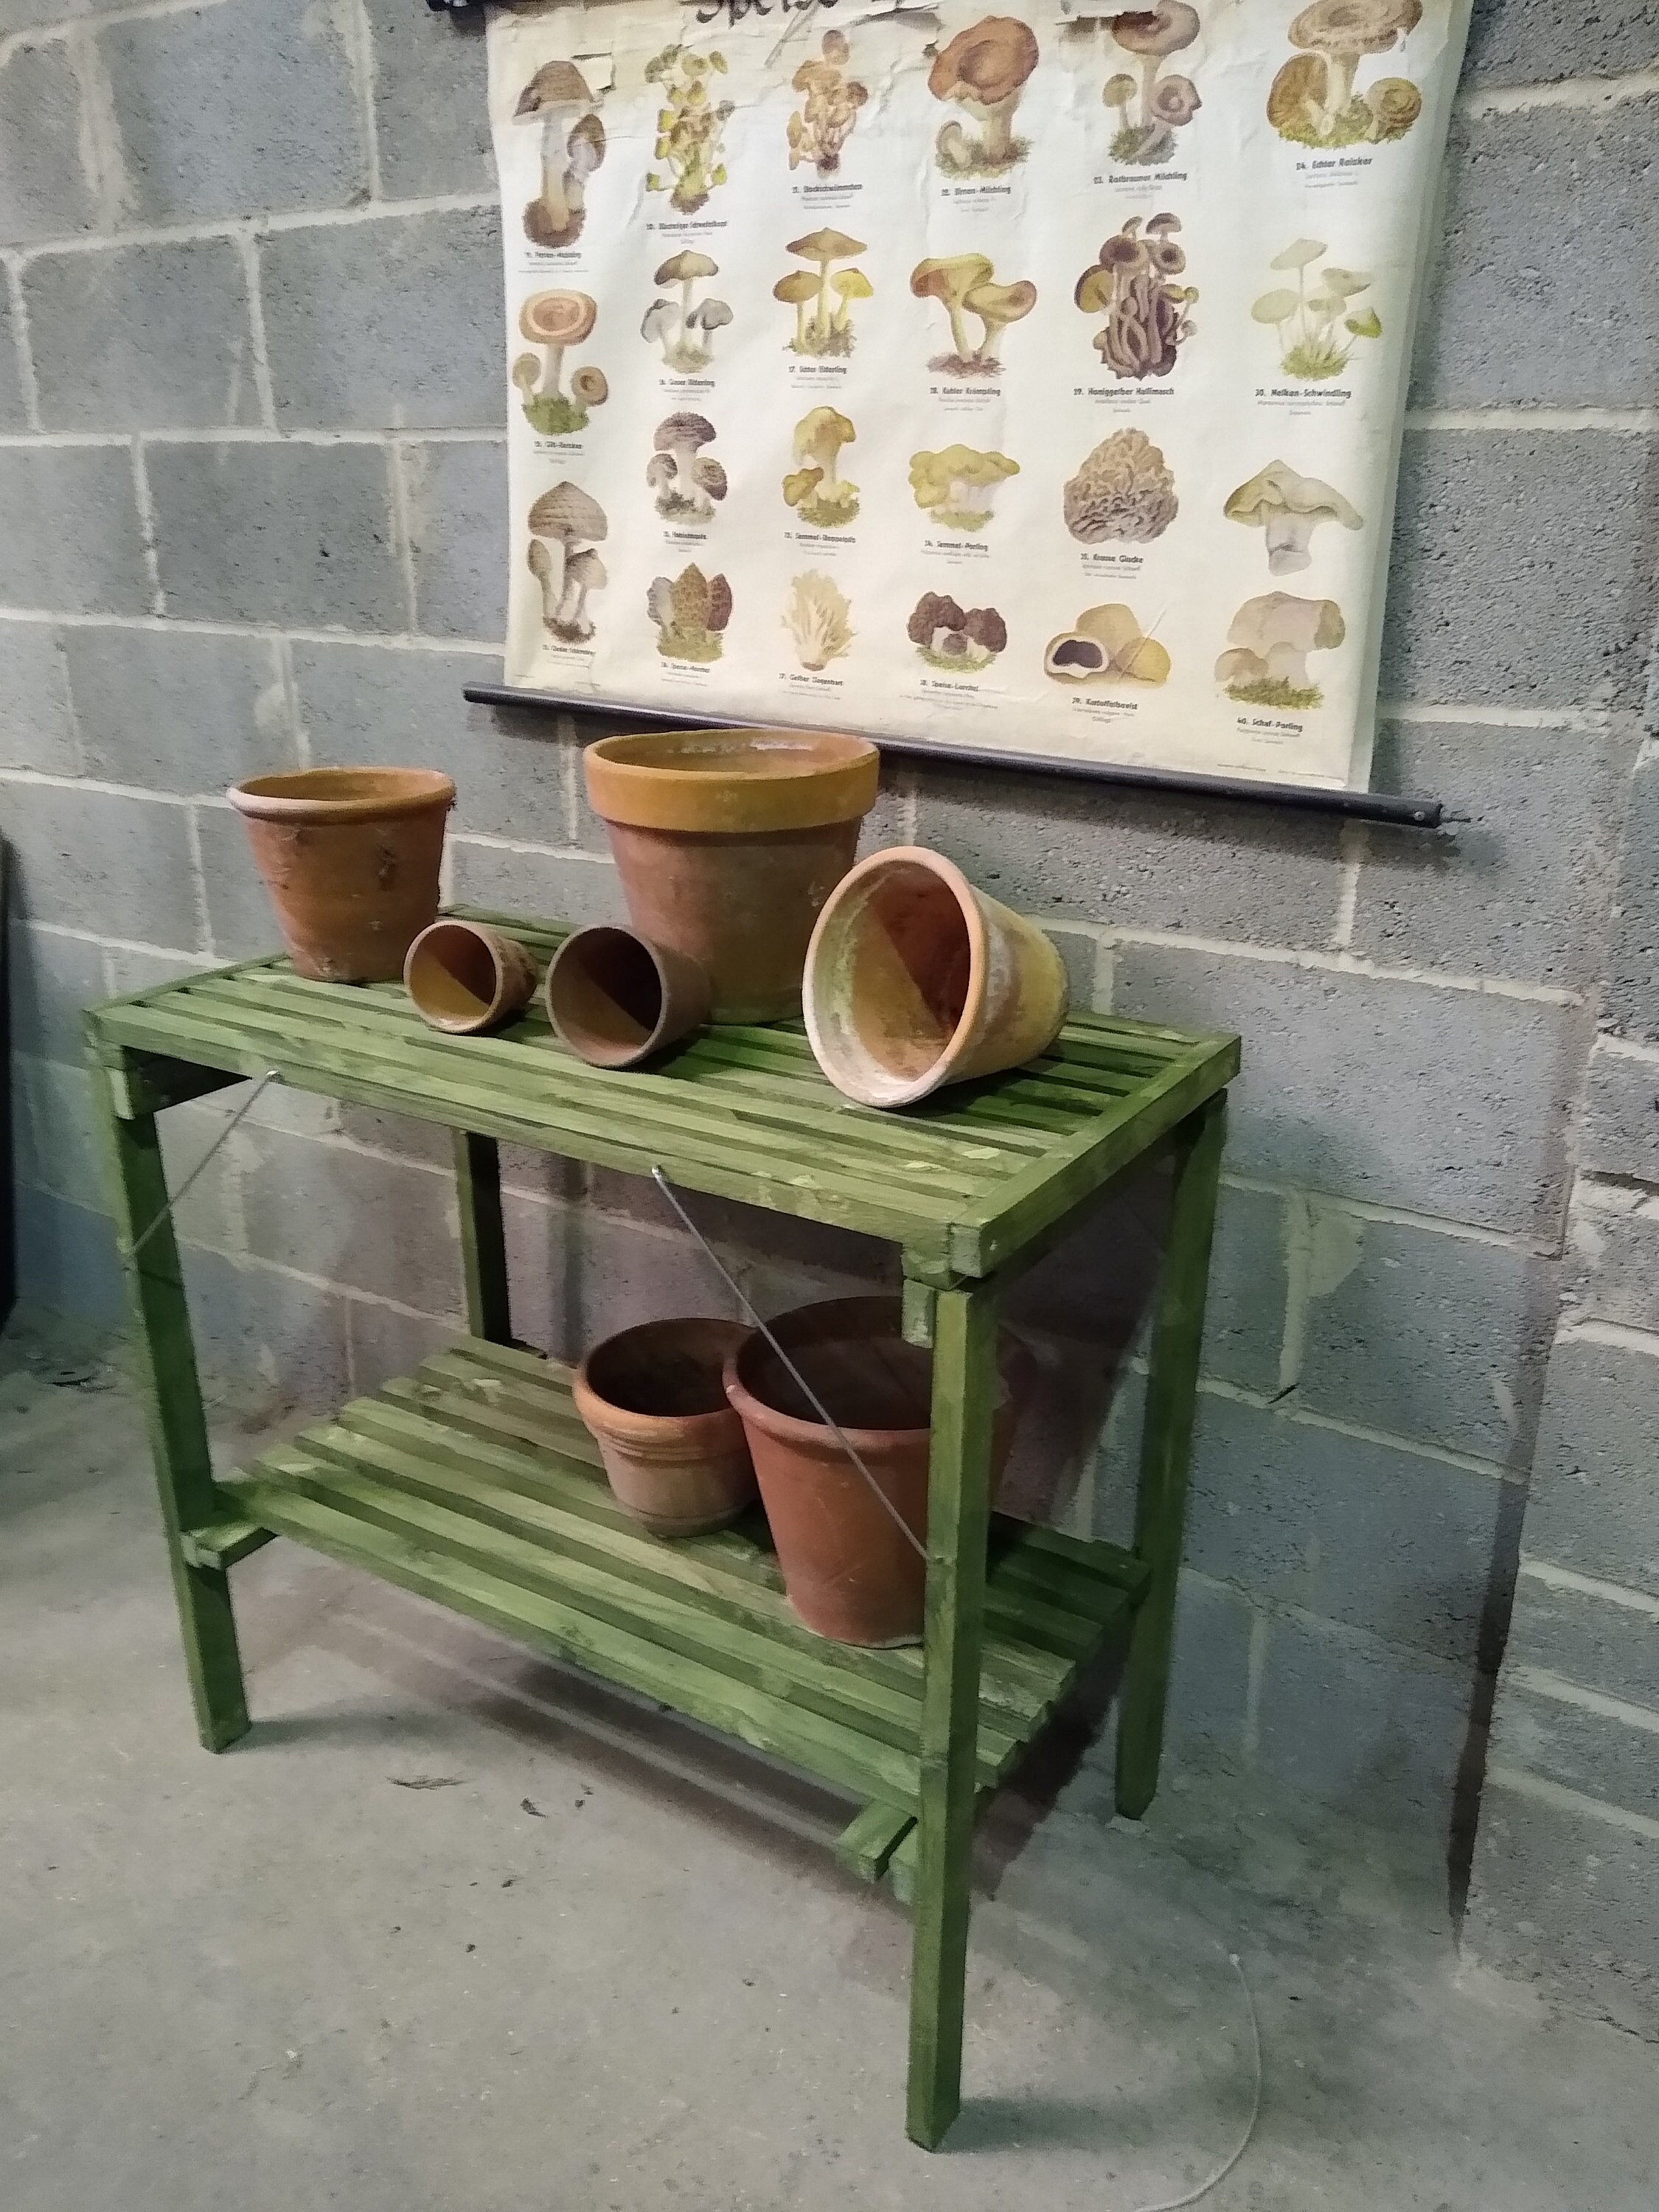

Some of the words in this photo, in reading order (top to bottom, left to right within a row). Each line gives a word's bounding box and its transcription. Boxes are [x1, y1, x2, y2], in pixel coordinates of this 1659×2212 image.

[1088, 388, 1134, 397] Honiggelber
[1135, 386, 1175, 396] Hallimasch
[1085, 698, 1138, 710] Kartoffelbovist
[1252, 718, 1303, 732] Schaf-Porling
